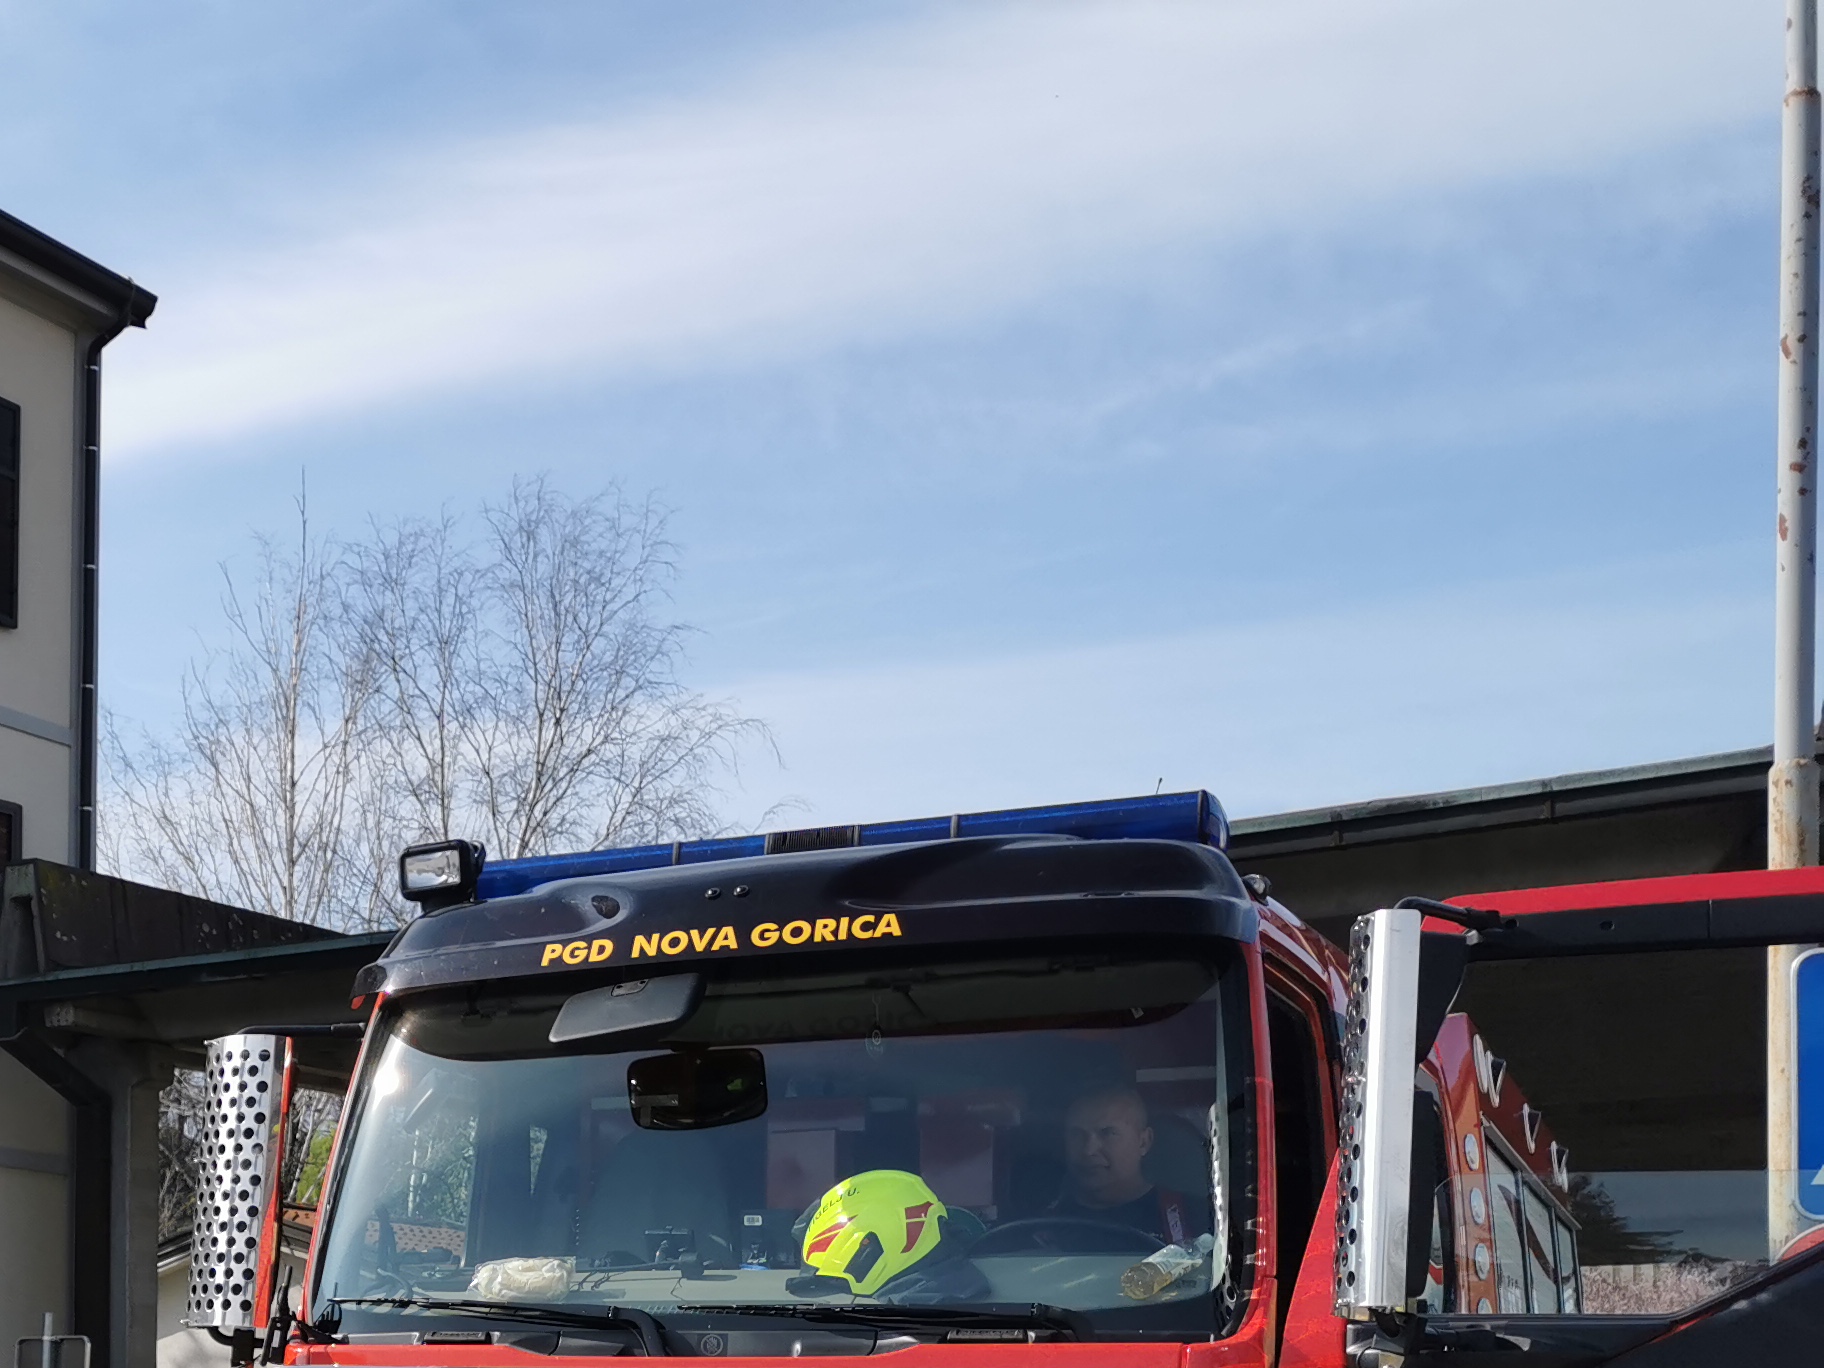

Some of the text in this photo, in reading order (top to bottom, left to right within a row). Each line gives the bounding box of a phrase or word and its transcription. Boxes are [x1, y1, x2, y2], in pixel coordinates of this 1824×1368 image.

[540, 912, 903, 967] PGD NOVA GORICA
